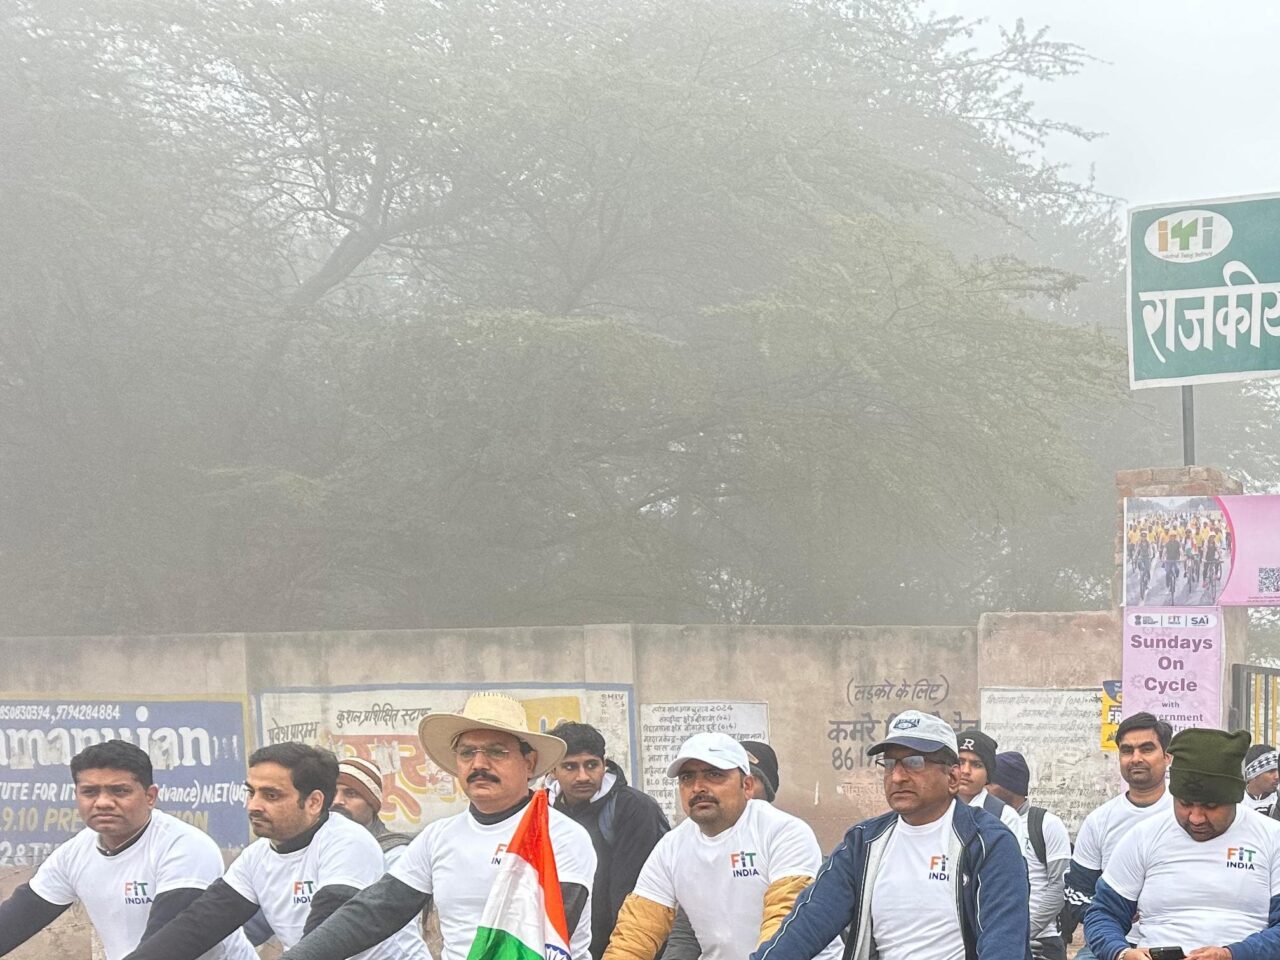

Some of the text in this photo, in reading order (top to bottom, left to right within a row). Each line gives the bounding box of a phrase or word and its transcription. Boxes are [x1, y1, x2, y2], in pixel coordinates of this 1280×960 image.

[1130, 634, 1213, 653] Sundays
[1158, 656, 1184, 670] On
[895, 678, 912, 700] के
[1144, 677, 1198, 694] Cycle
[827, 711, 882, 743] कमरे
[959, 738, 975, 751] R
[32, 782, 57, 803] FOR
[1226, 860, 1255, 871] INDIA
[733, 868, 760, 878] INDIA
[928, 872, 949, 881] INDI
[125, 896, 153, 905] INDIA
